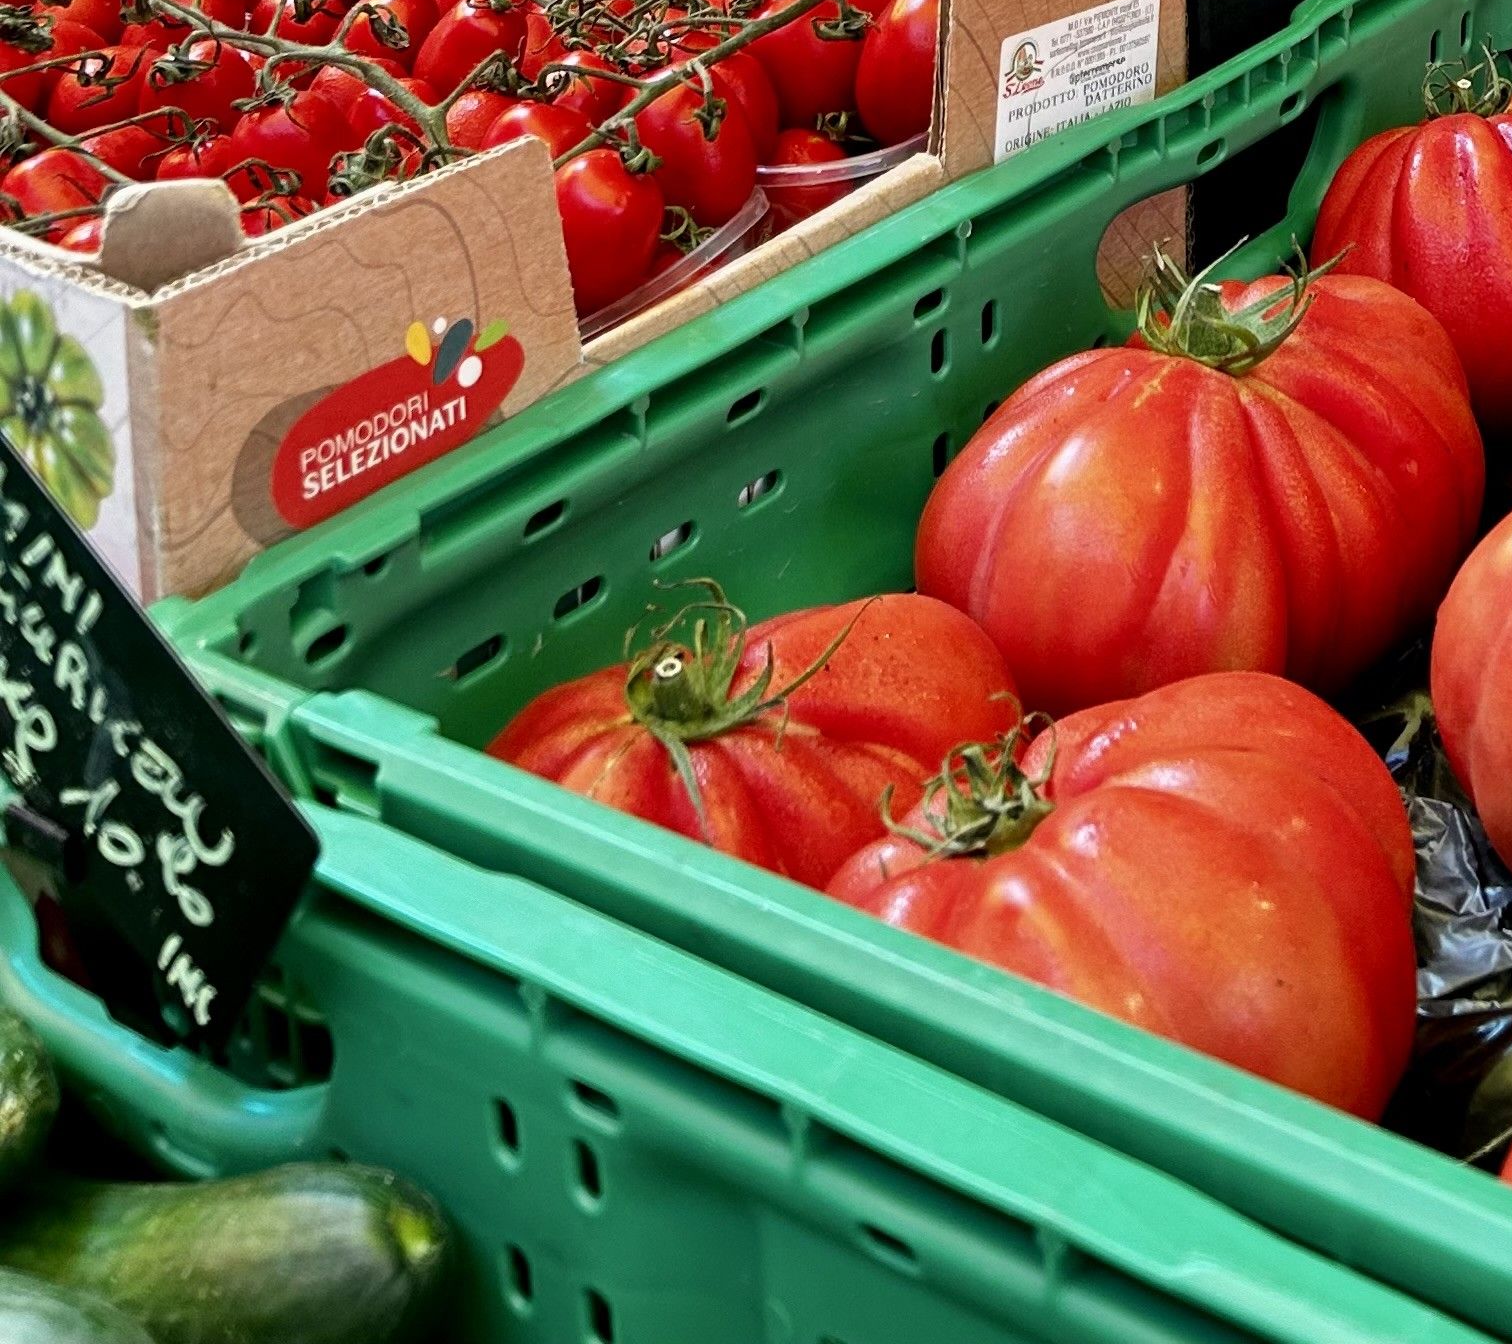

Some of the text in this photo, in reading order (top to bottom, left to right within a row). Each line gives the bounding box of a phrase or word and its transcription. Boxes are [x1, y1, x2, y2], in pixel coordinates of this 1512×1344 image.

[1008, 88, 1077, 124] PRODOTTO
[1083, 61, 1150, 97] POMODORO
[1084, 73, 1153, 108] DATTERINO
[300, 389, 429, 474] POMODORI
[302, 395, 467, 501] SELEZIONATI
